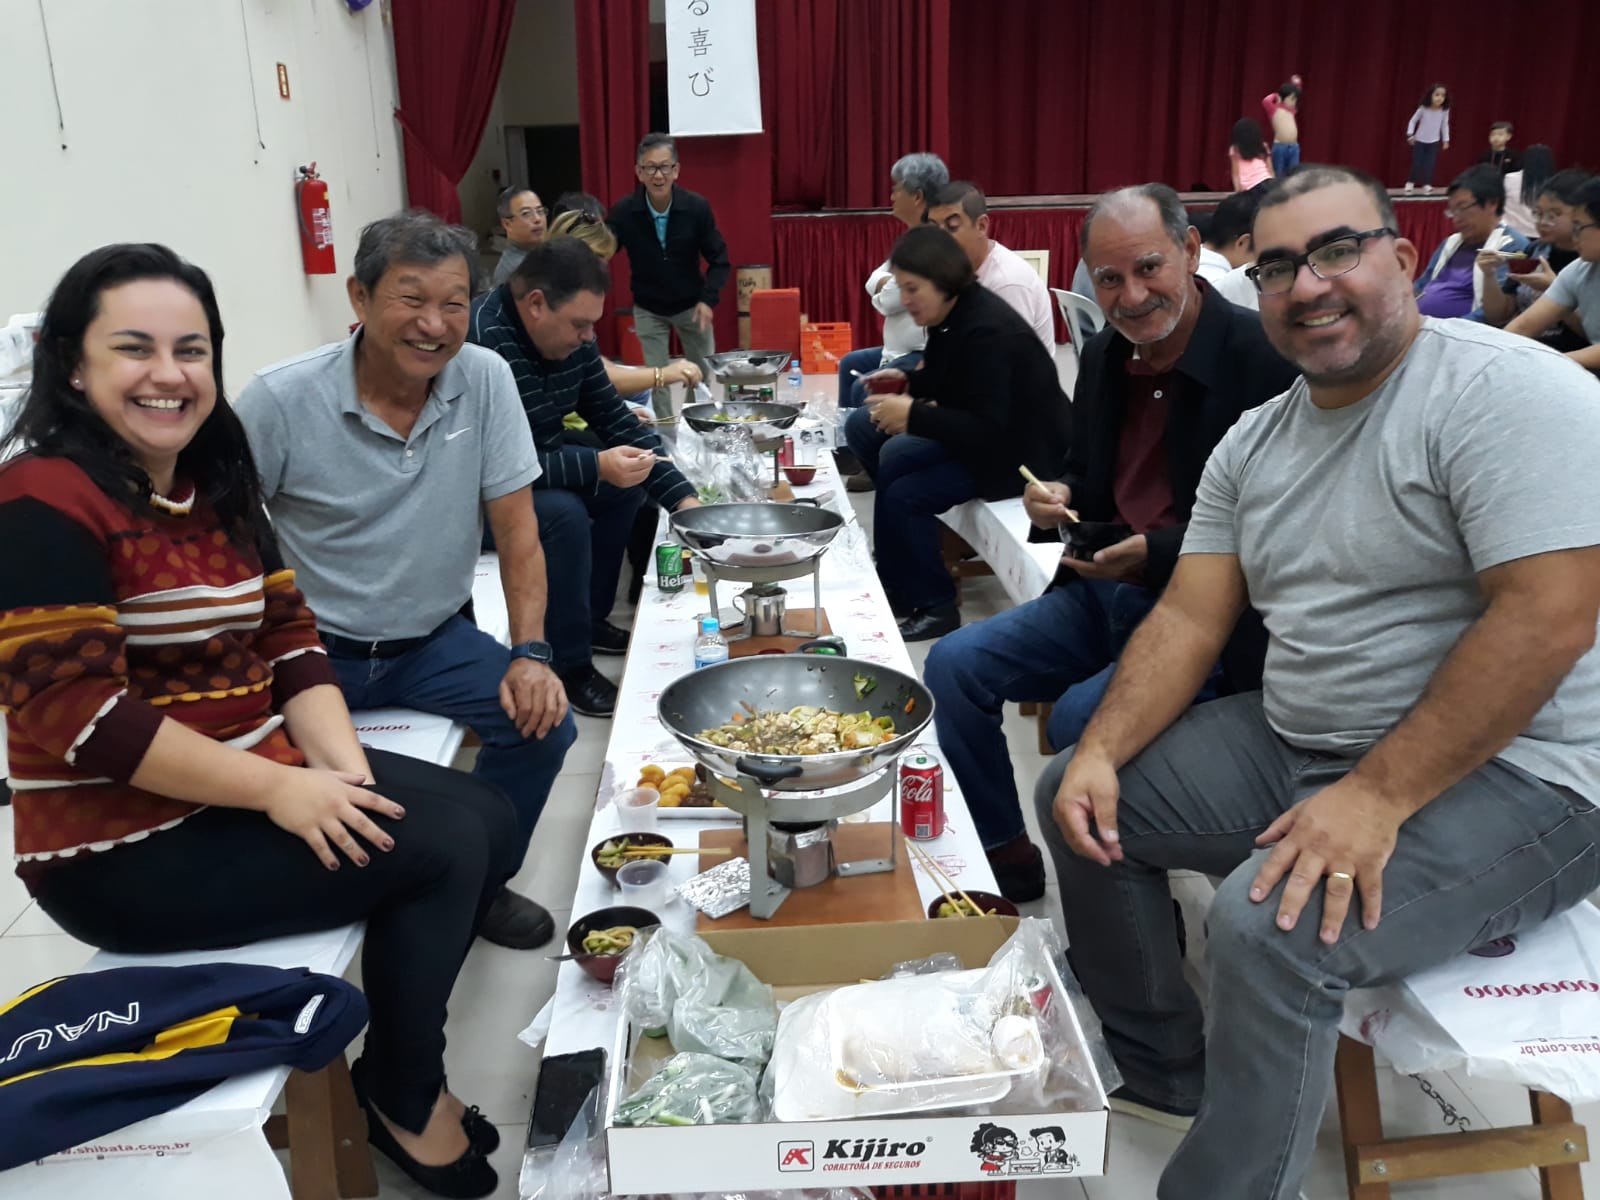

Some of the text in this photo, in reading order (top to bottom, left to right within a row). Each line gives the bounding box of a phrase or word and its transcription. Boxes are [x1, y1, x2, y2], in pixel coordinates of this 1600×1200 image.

[0, 1001, 139, 1063] NAU
[823, 1160, 921, 1171] CORRETORA DE SEGUROS
